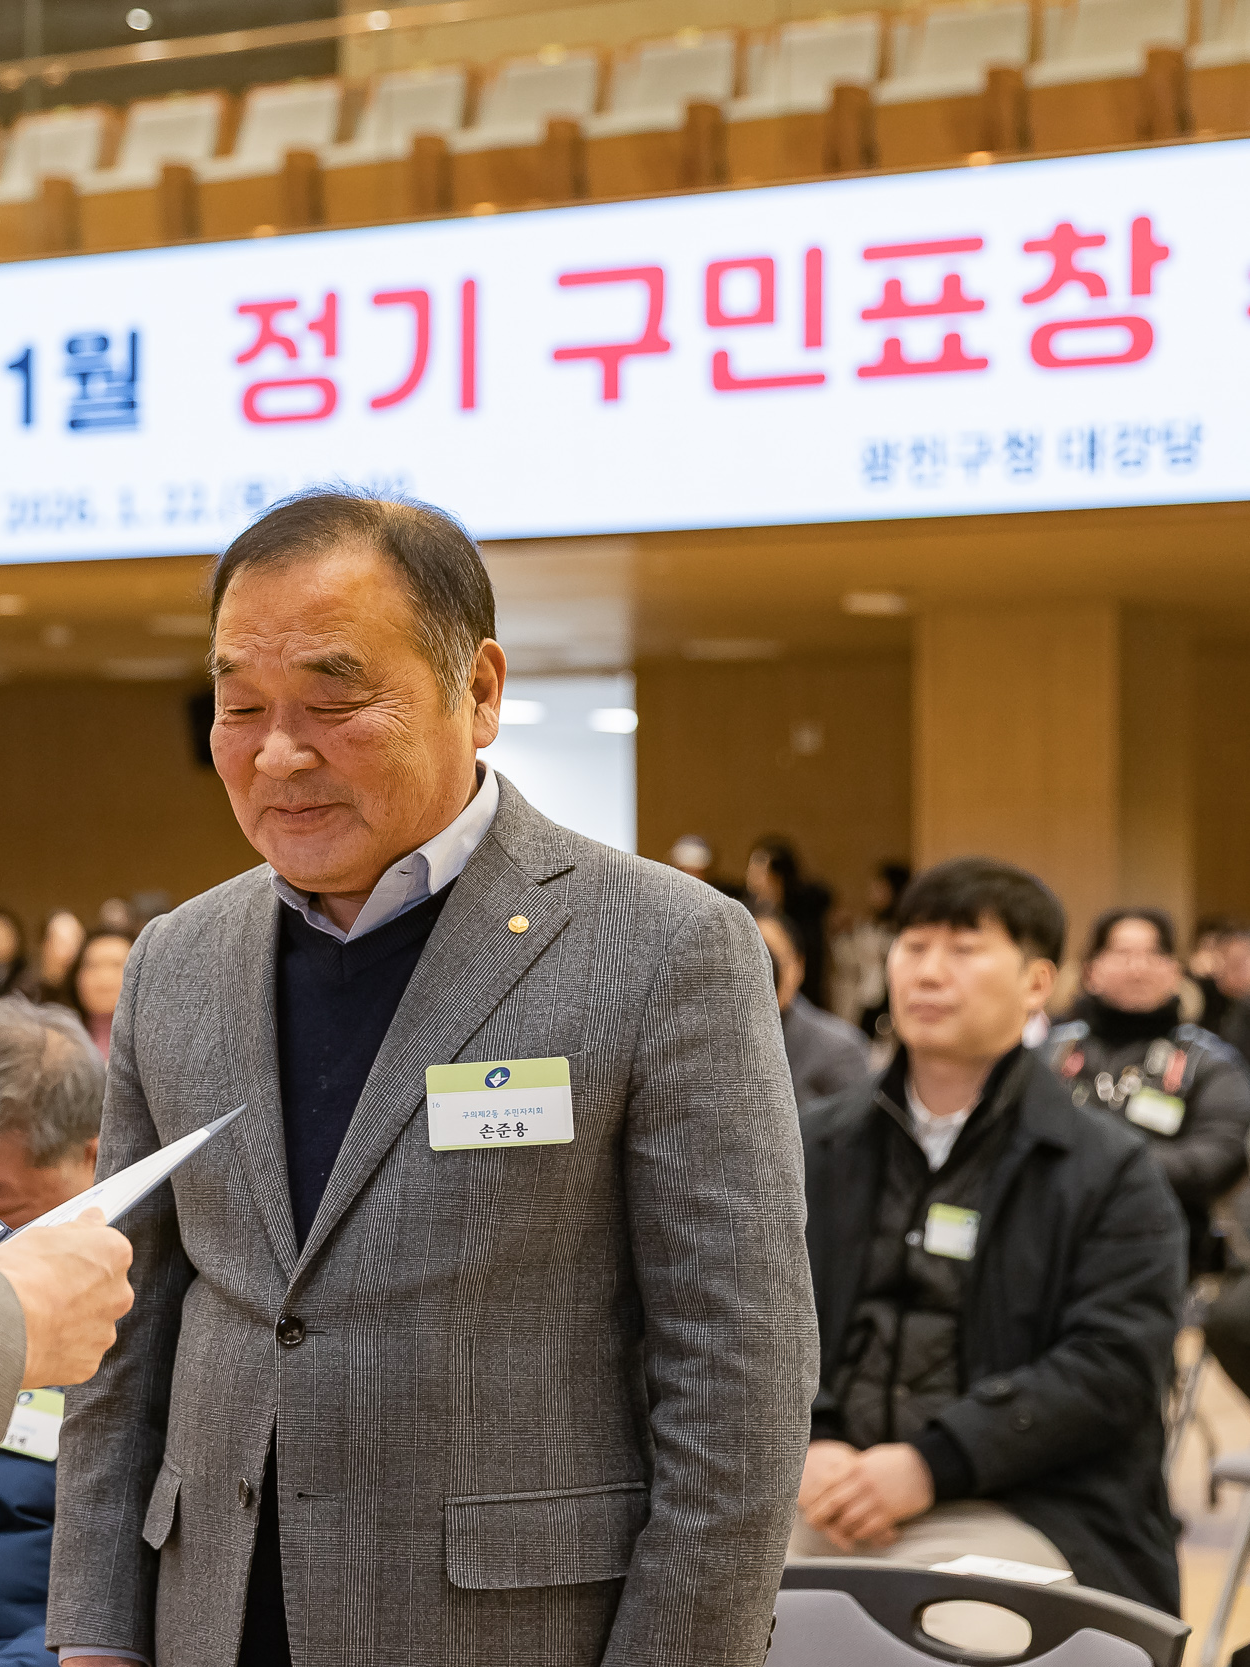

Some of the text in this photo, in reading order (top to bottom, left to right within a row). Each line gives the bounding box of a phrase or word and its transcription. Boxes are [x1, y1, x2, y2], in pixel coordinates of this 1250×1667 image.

[5, 329, 142, 434] 1월
[235, 278, 477, 425] 정기
[553, 216, 1170, 401] 구민표창
[431, 1101, 441, 1109] 16
[462, 1106, 544, 1119] 구의제2동 주민자치회
[479, 1121, 529, 1139] 손준용
